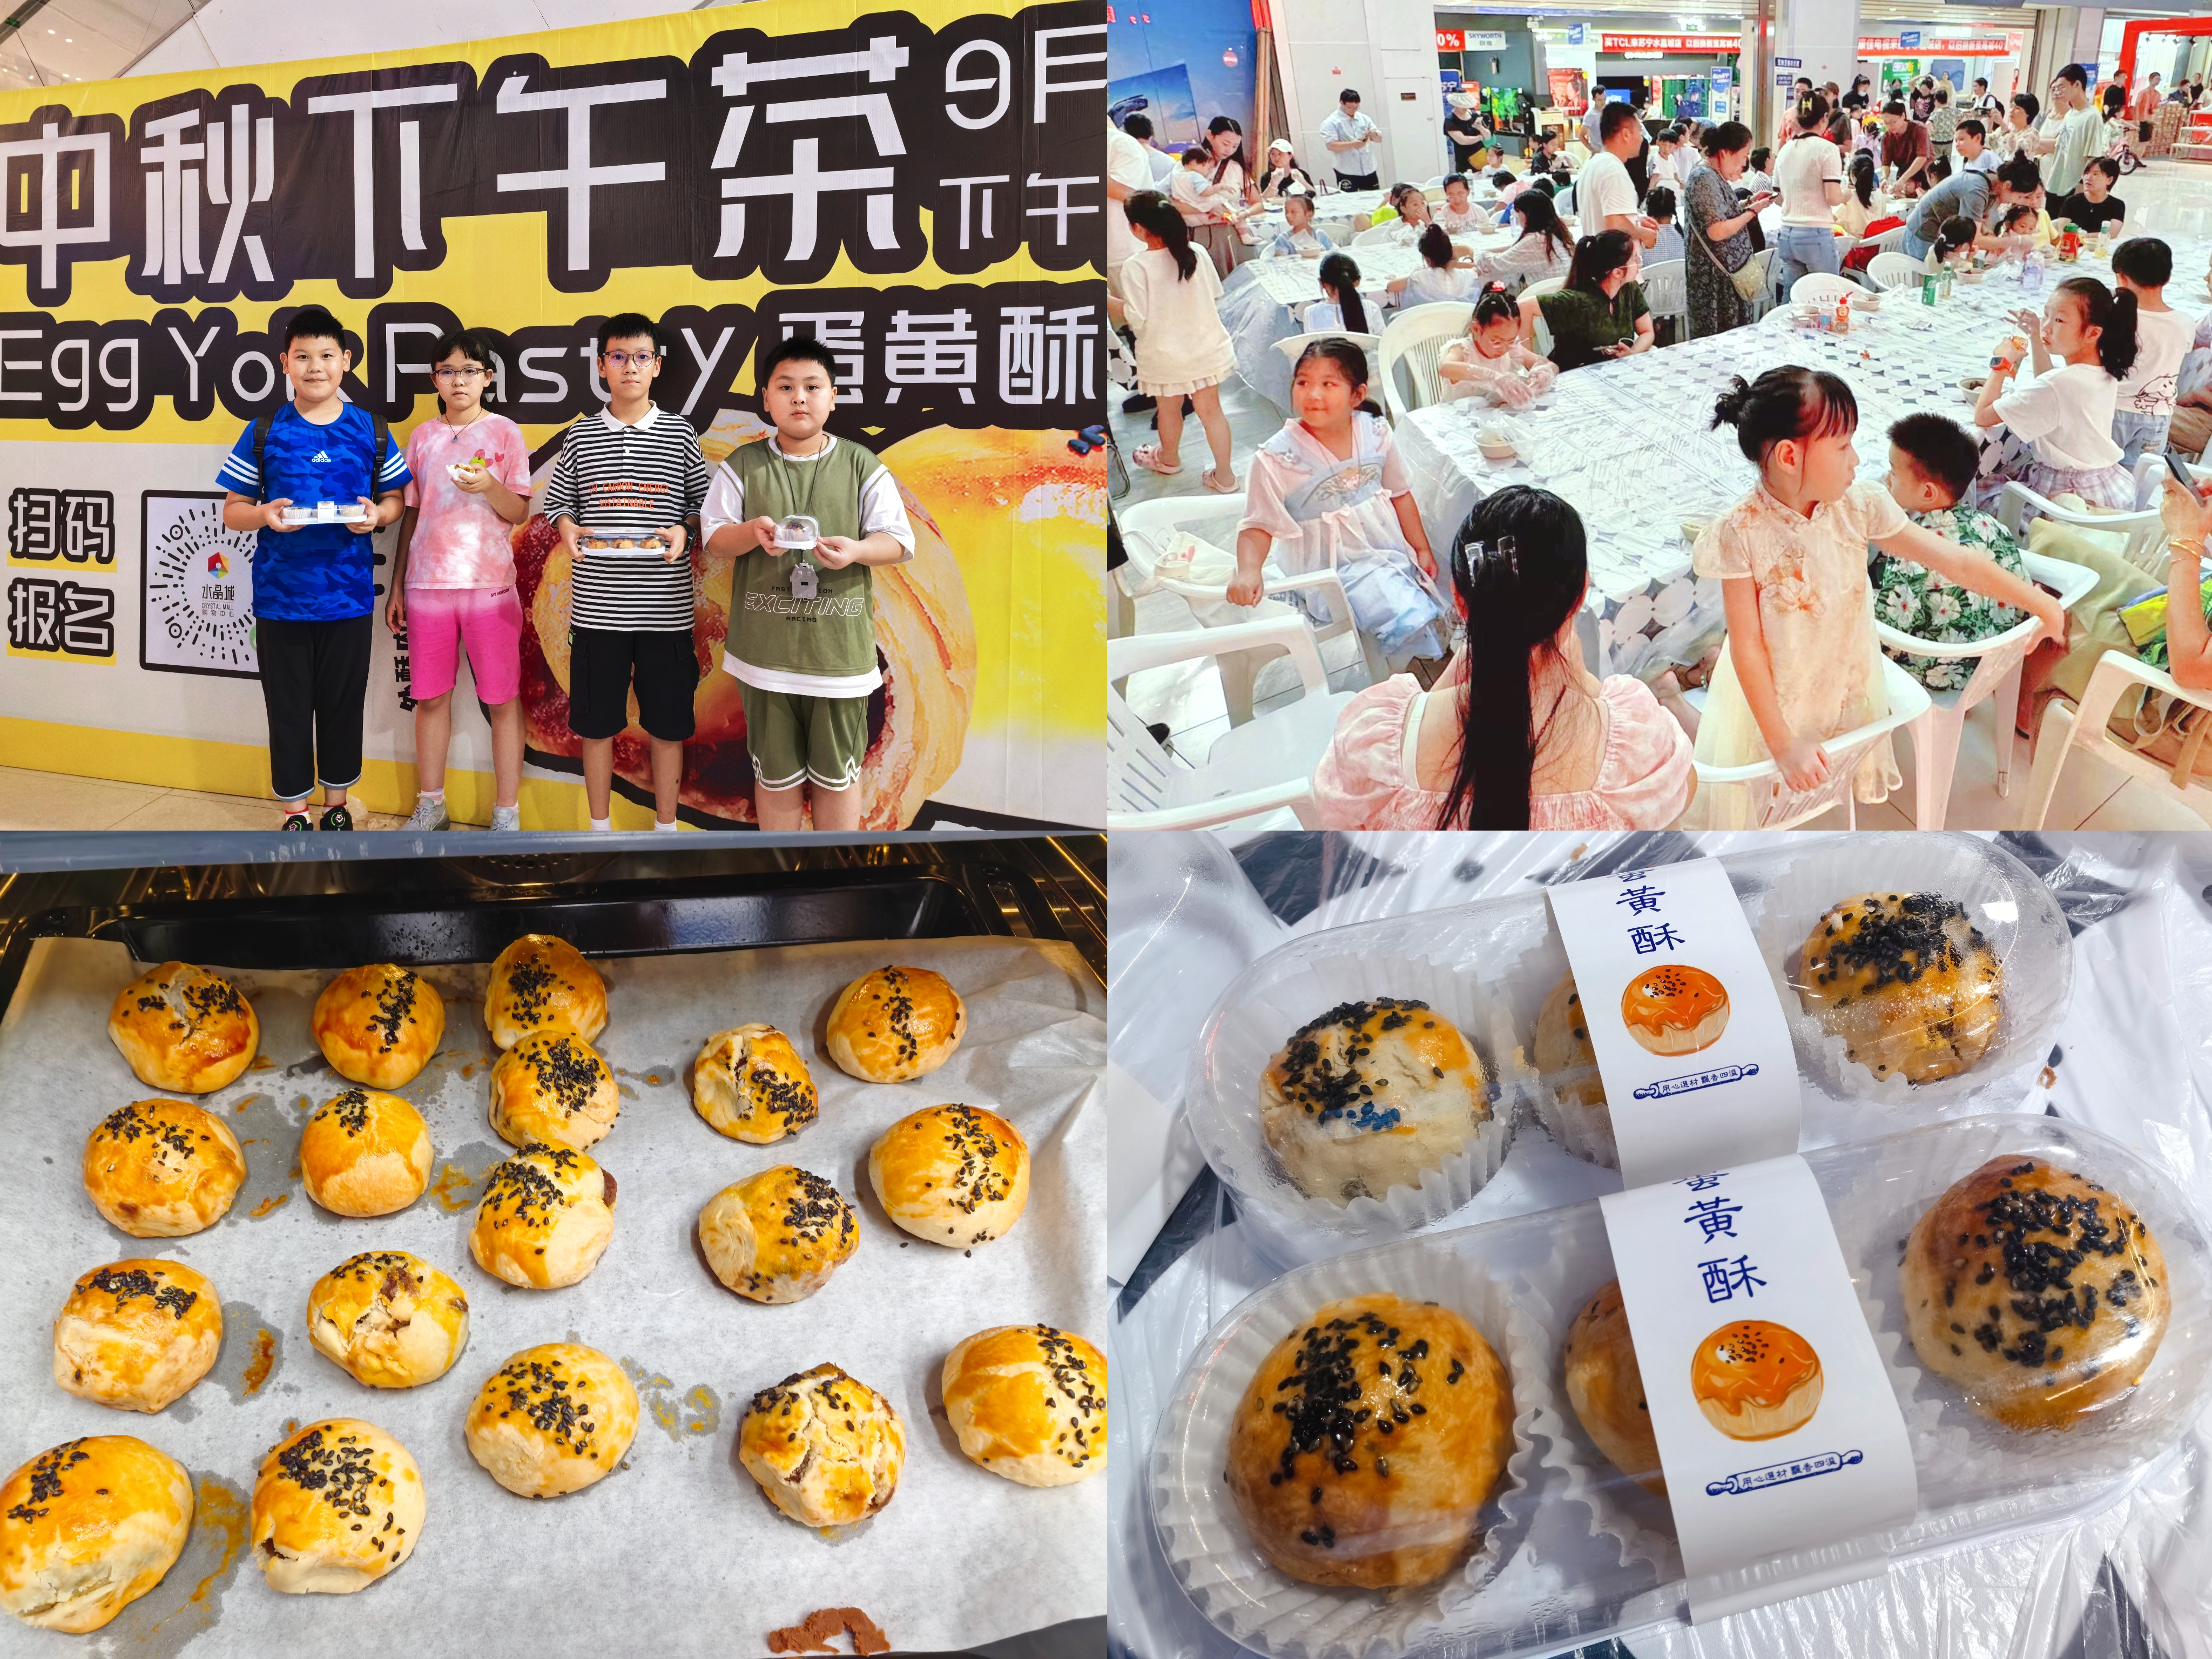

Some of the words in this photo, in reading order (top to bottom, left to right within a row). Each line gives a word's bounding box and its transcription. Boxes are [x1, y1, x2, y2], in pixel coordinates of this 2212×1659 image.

[0, 36, 909, 288] 中秋下午茶
[940, 173, 1100, 249] 下午
[0, 326, 139, 412] Egg
[167, 326, 354, 402] Yo
[598, 498, 655, 509] SUSTAINABLE
[603, 481, 633, 492] CARBON
[638, 483, 669, 494] ENERGY
[12, 494, 109, 558] 扫码
[12, 584, 109, 650] 报名
[202, 584, 234, 601] 水晶城
[745, 592, 864, 616] EXCITING
